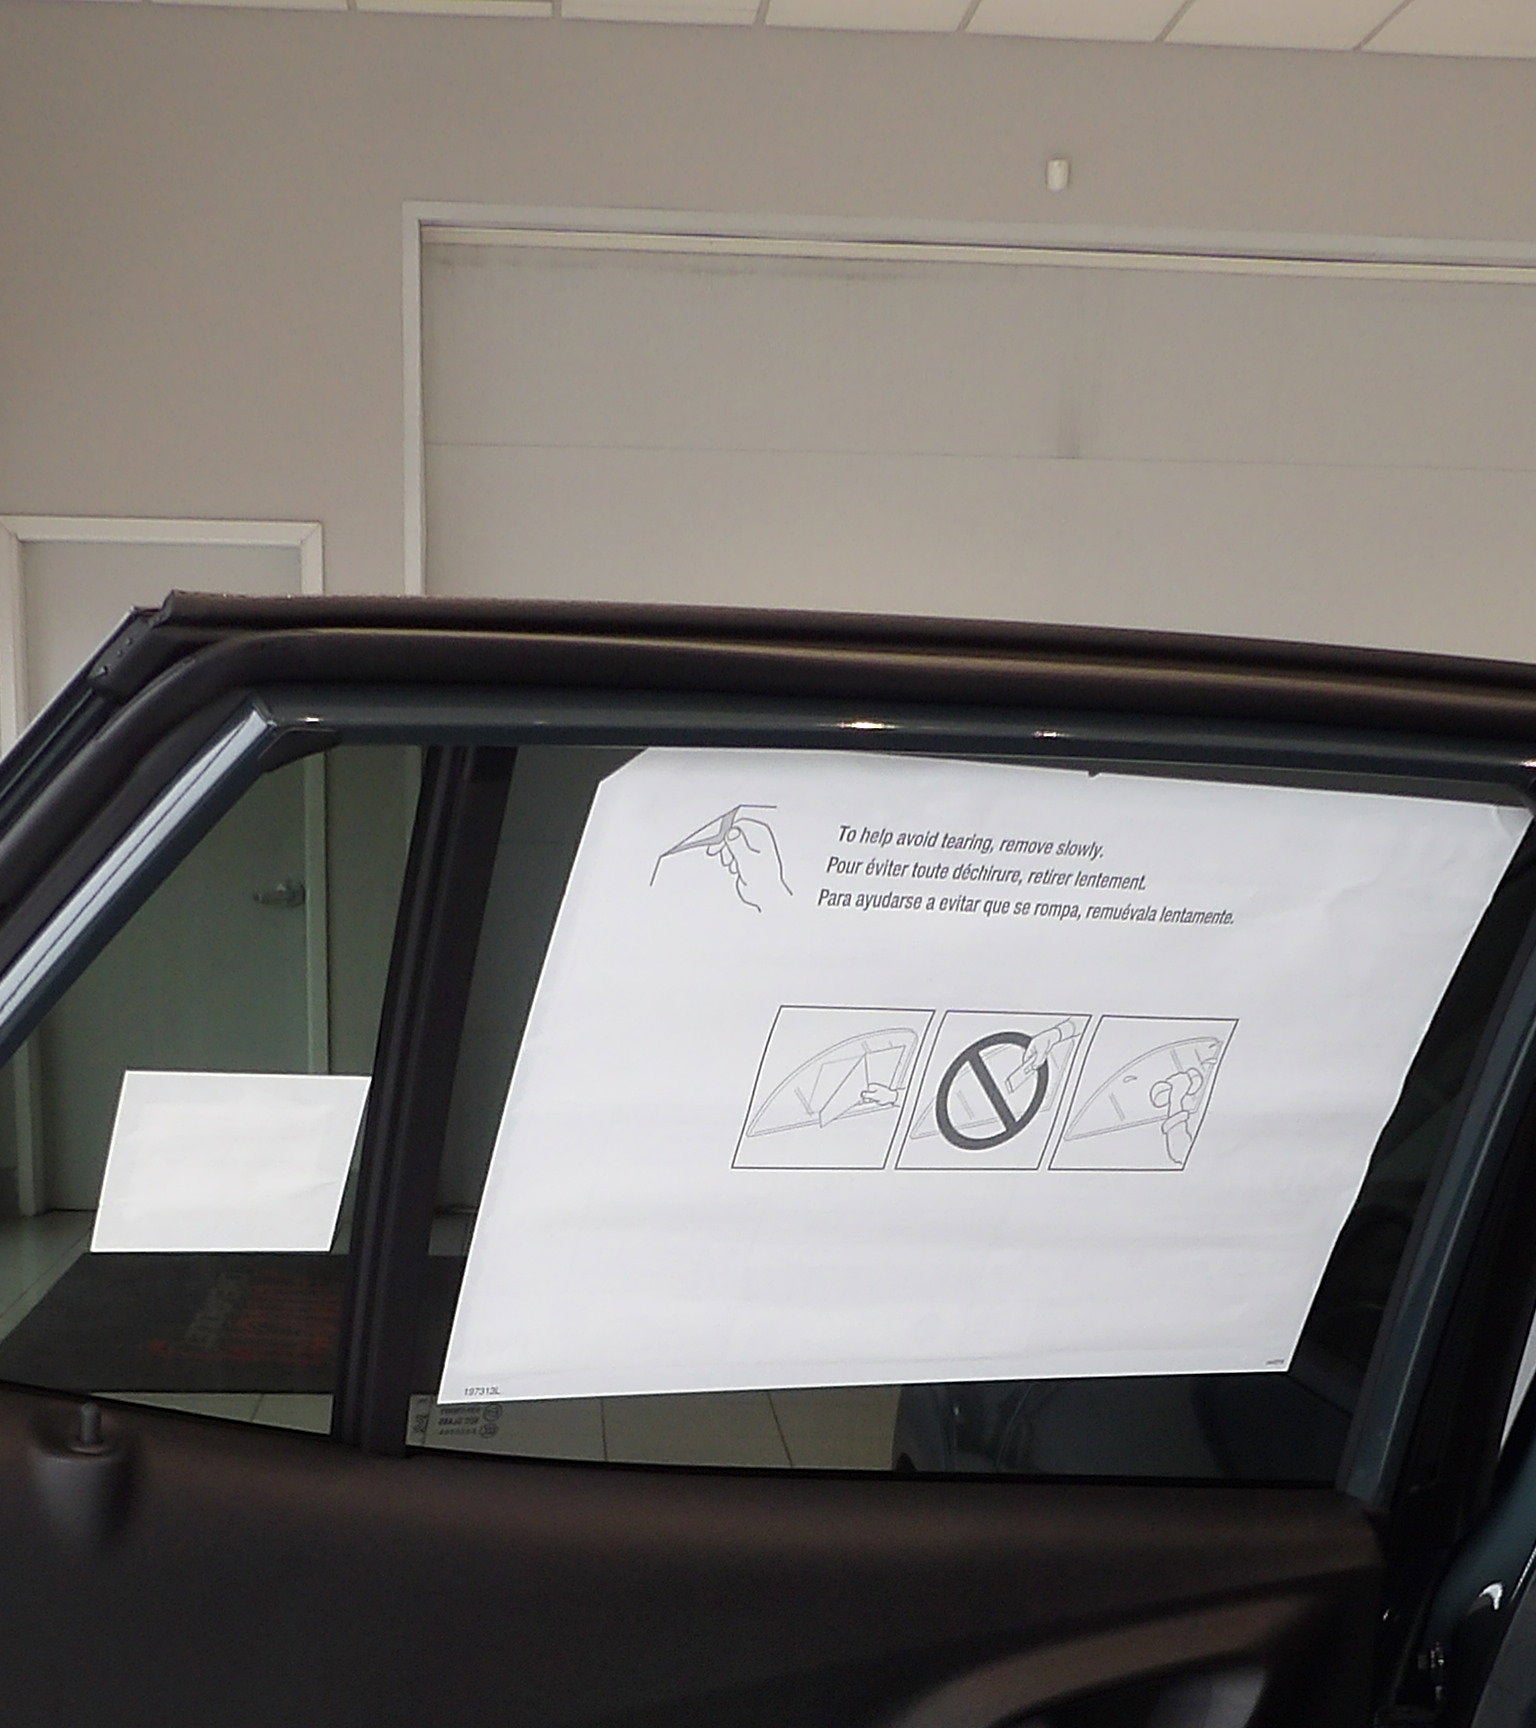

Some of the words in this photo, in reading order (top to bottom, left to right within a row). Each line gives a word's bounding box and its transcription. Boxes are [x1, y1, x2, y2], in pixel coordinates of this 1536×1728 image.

[838, 824, 857, 843] To
[859, 826, 894, 848] help
[895, 830, 940, 848] avoid
[941, 832, 995, 854] tearing,
[998, 839, 1054, 856] remove
[1055, 840, 1104, 862] slowly.
[826, 855, 864, 875] Pour
[865, 857, 910, 878] éviter
[911, 861, 950, 880] toute
[951, 863, 1024, 886] déchirure,
[1026, 868, 1074, 886] retirer
[817, 888, 852, 908] Para
[854, 891, 923, 912] ayudarse
[925, 896, 936, 911] a
[938, 894, 982, 913] evitar
[982, 899, 1011, 918] que
[1012, 901, 1032, 916] se
[1033, 902, 1082, 922] rompa,
[1085, 903, 1158, 922] remuévala
[1159, 905, 1236, 926] lentamente.
